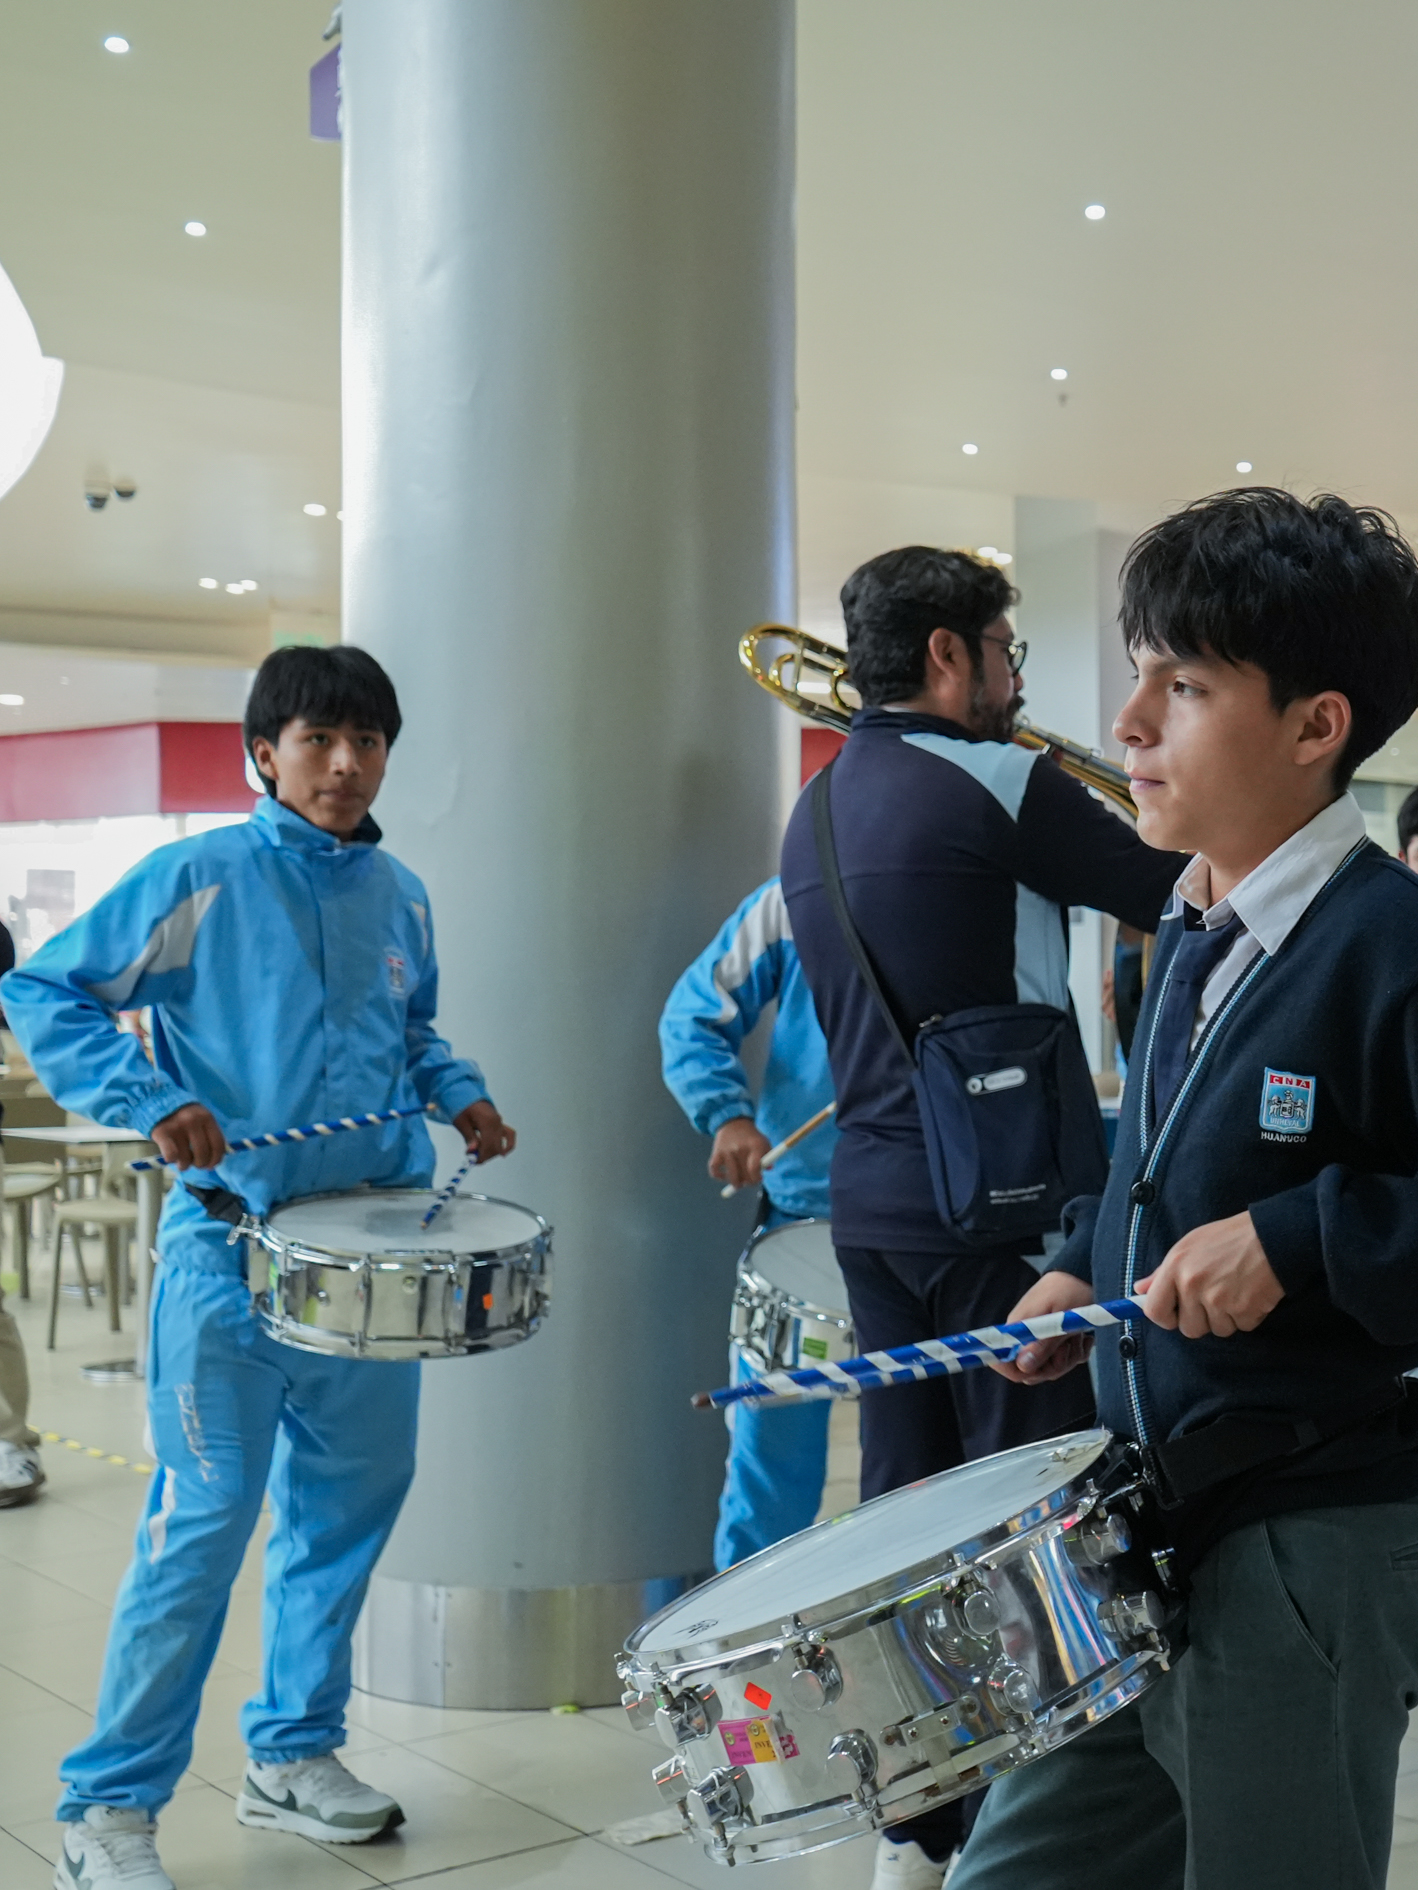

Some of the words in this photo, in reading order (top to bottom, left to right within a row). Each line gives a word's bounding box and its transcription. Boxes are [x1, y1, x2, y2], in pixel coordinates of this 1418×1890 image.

[1272, 1076, 1308, 1088] CNA
[1270, 1117, 1301, 1127] UNHEVAL
[1260, 1131, 1307, 1143] HUANUCO
